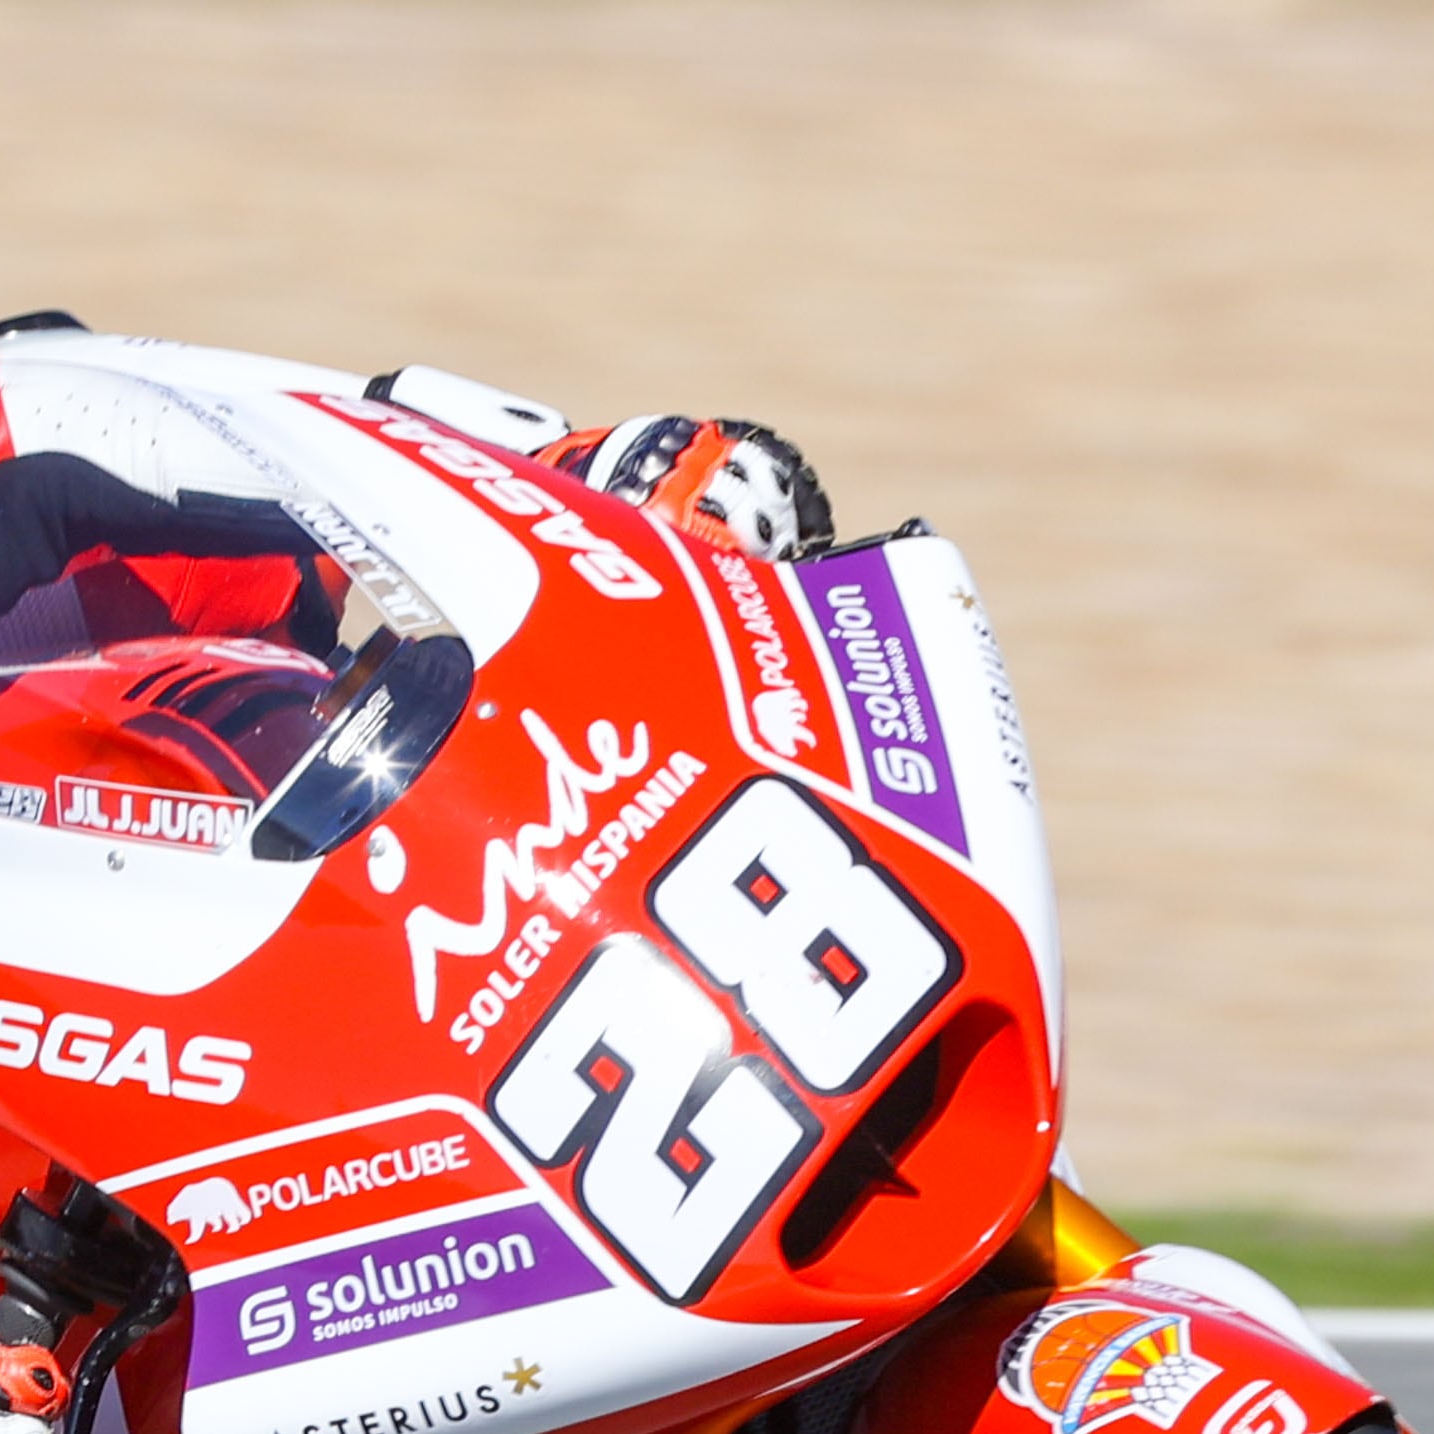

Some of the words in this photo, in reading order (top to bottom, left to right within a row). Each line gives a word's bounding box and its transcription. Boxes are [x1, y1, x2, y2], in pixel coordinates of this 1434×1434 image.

[712, 552, 795, 688] POLARCUBE
[826, 584, 909, 741] solunion
[973, 620, 1031, 799] ASTERIUS
[448, 913, 564, 1056] SOLER
[548, 749, 708, 920] HISPANIA
[487, 772, 965, 1305] 28
[248, 1133, 470, 1218] POLARCUBE
[308, 1232, 536, 1322] solunion
[312, 1315, 376, 1343] SOMOS
[377, 1293, 460, 1330] IMPULSO
